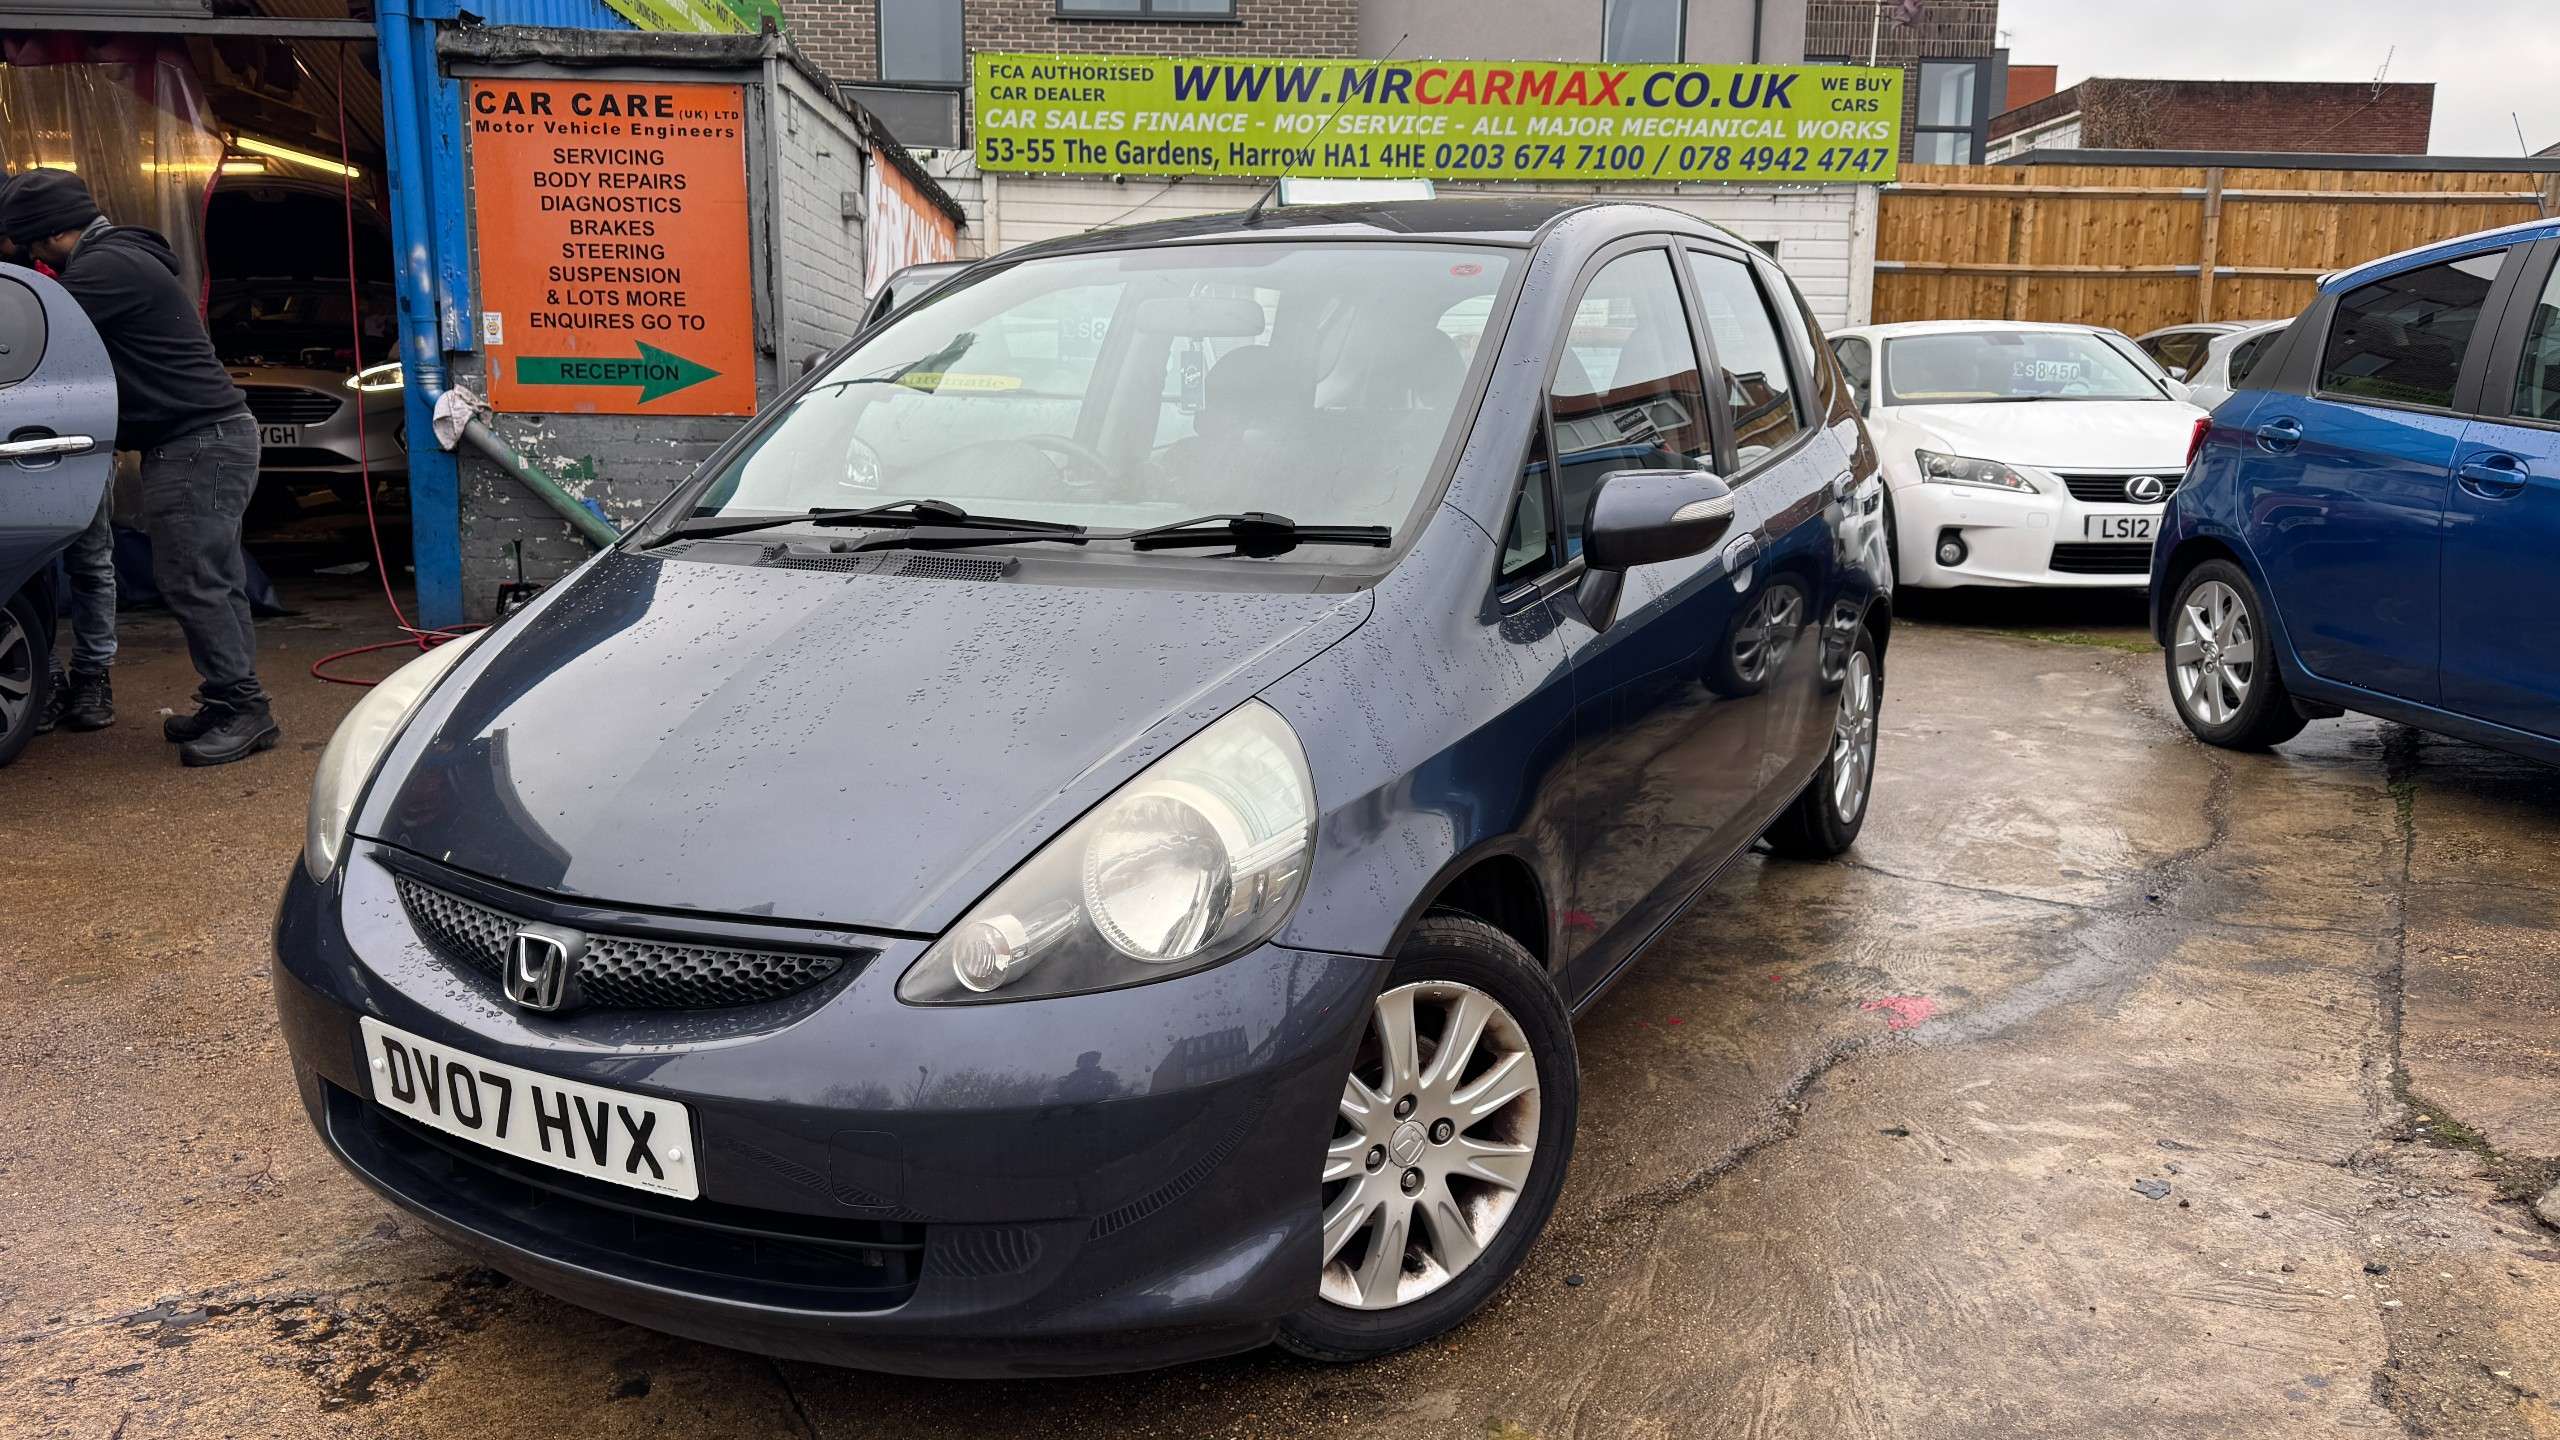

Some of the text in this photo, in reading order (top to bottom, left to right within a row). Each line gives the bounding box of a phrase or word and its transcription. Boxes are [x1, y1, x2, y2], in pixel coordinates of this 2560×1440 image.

[991, 65, 1153, 81] FCA AUTHORISED
[1174, 66, 1798, 108] WWW.MRCARMAX.CO.UK
[1822, 78, 1892, 91] WE BUY
[991, 86, 1105, 101] CAR DEALER
[475, 91, 740, 121] CAR CARE (UK) LTD
[1832, 99, 1878, 112] CARS
[476, 120, 734, 139] Motor Vehicle Engineers
[987, 110, 1035, 127] CAR
[1046, 111, 1124, 129] SALES
[1134, 113, 1247, 131] FINANCE
[1274, 114, 1333, 133] MOT
[1338, 115, 1446, 134] SERVICE
[1473, 118, 1516, 135] ALL
[1528, 118, 1613, 135] MAJOR
[1623, 119, 1784, 137] MECHANICAL
[1799, 121, 1888, 139] WORKS
[554, 148, 663, 165] SERVICING
[986, 138, 1888, 175] 53-55 The Gardens, Harrow HA1 4HE 0203 674 7100 / 078 4942 4747
[534, 172, 686, 190] BODY REPAIRS
[541, 196, 681, 213] DIAGNOSTICS
[571, 220, 654, 236] BRAKES
[563, 243, 664, 260] STEERING
[550, 266, 680, 283] SUSPENSION
[547, 290, 686, 307] & LOTS MORE
[531, 313, 705, 330] ENQUIRES GO TO
[561, 364, 680, 381] RECEPTION
[262, 427, 292, 443] YGH
[2102, 519, 2150, 539] LS12
[382, 1035, 665, 1180] DV07 HVX
